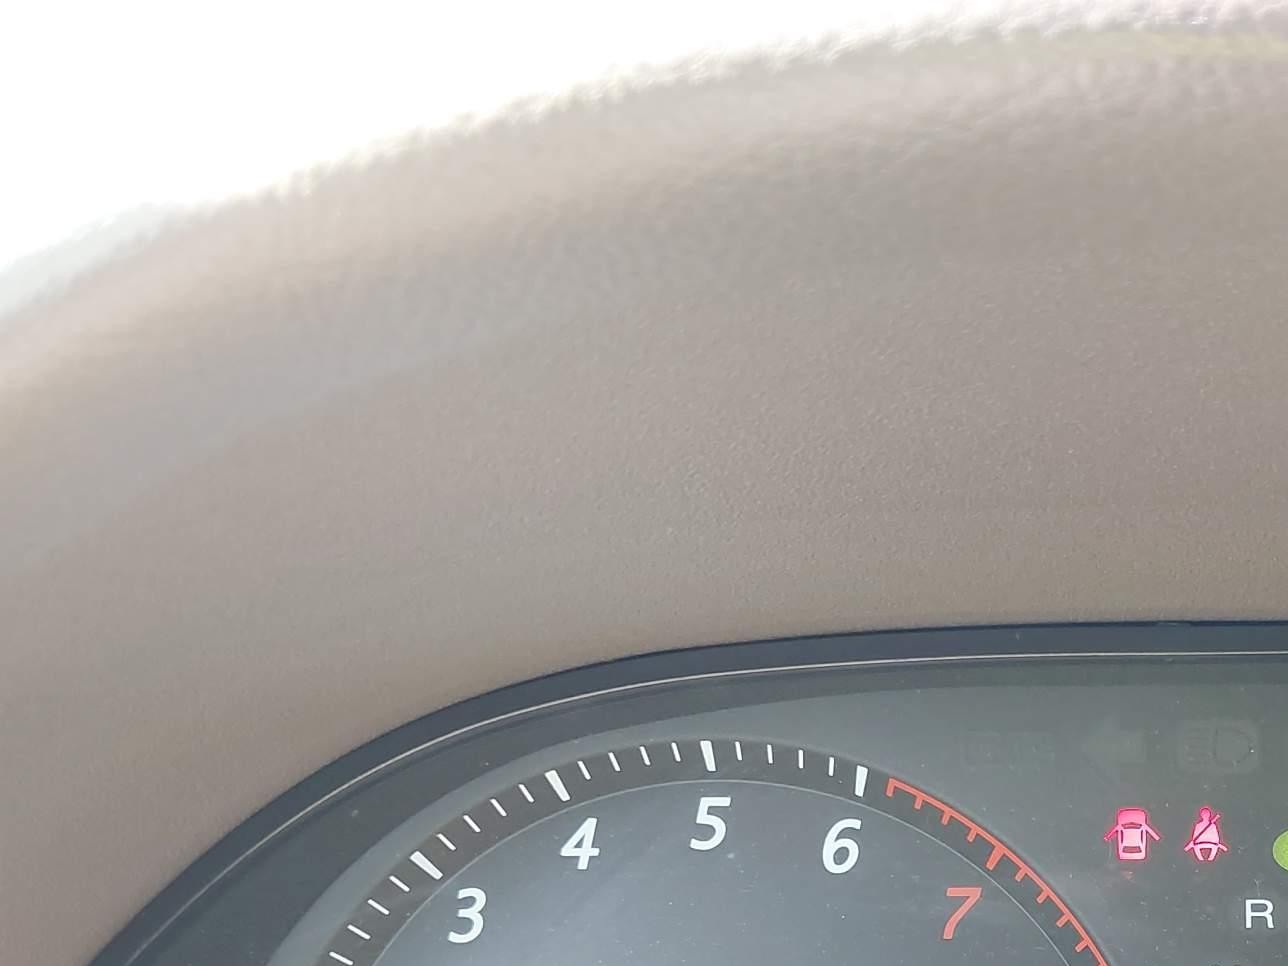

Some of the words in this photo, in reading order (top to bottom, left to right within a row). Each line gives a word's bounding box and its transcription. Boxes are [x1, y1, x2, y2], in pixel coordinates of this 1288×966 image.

[560, 817, 600, 870] 4
[689, 796, 731, 850] 5
[822, 818, 862, 874] 6
[447, 888, 486, 943] 3
[941, 887, 982, 940] 7
[1245, 899, 1275, 929] R
